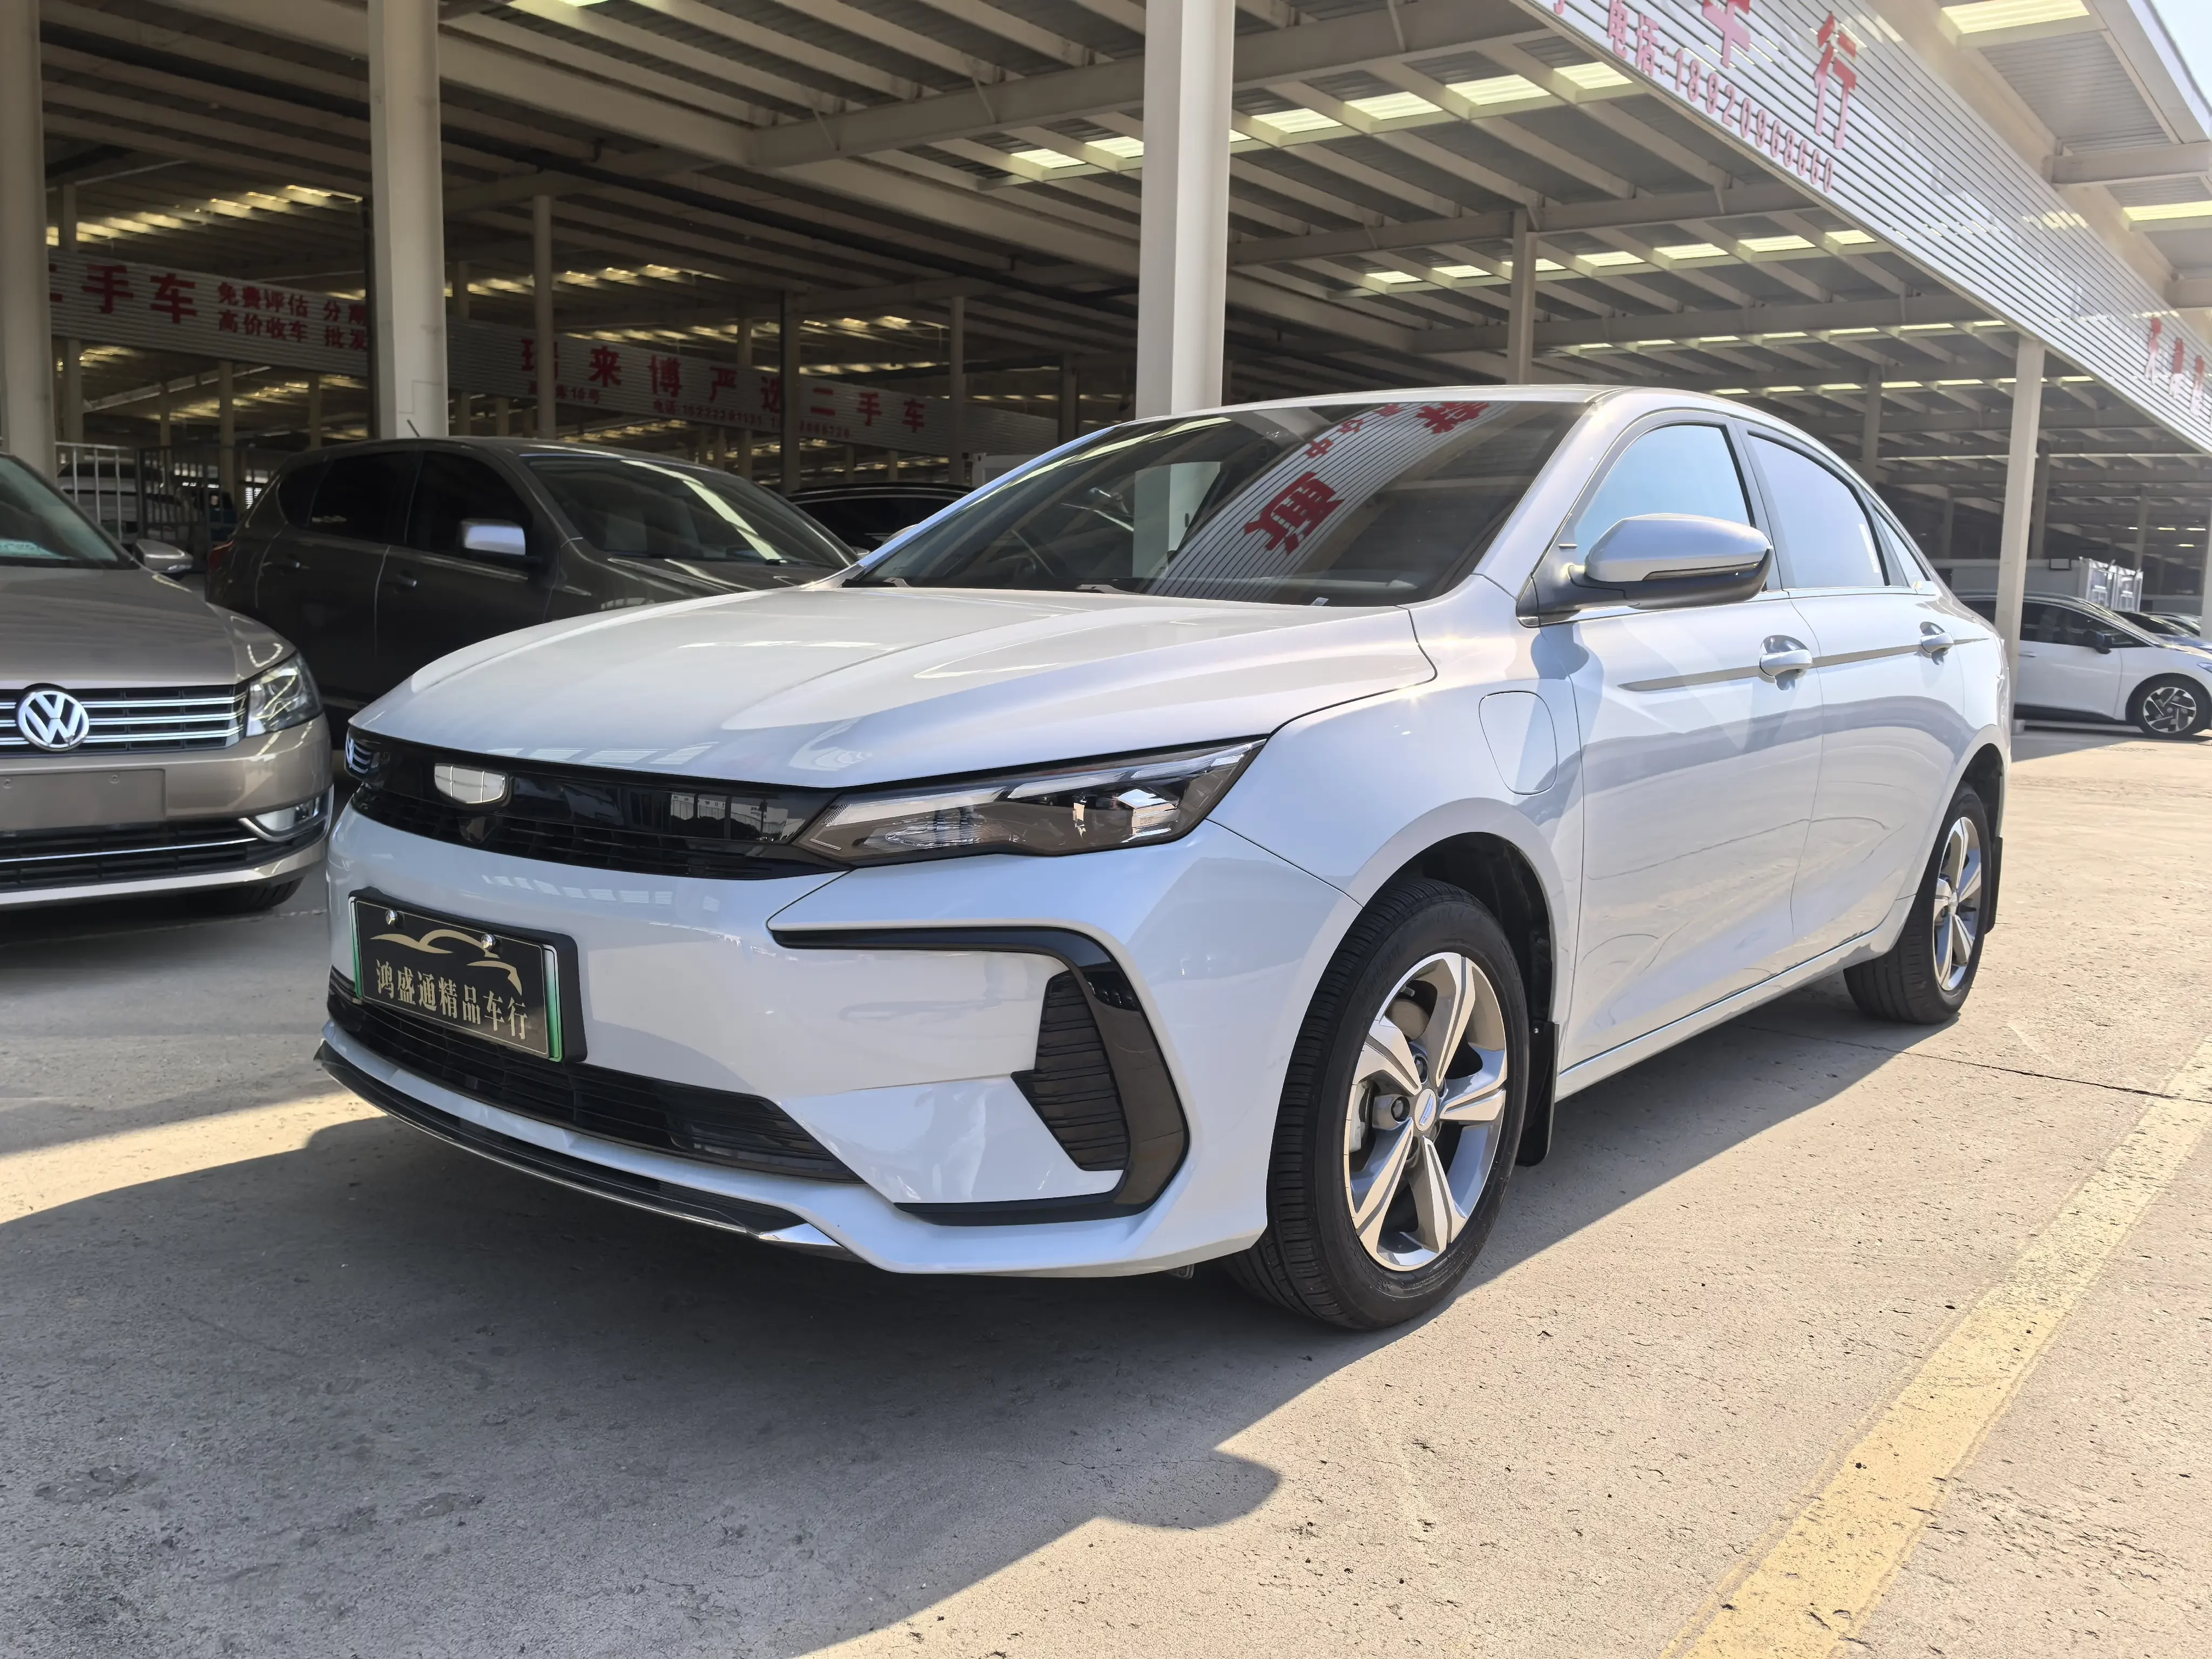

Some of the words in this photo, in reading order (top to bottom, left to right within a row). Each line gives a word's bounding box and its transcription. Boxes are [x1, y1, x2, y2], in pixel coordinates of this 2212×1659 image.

[50, 262, 197, 324] 手车
[21, 691, 87, 748] VW
[376, 959, 528, 1040] 鸿盛通精品车行
